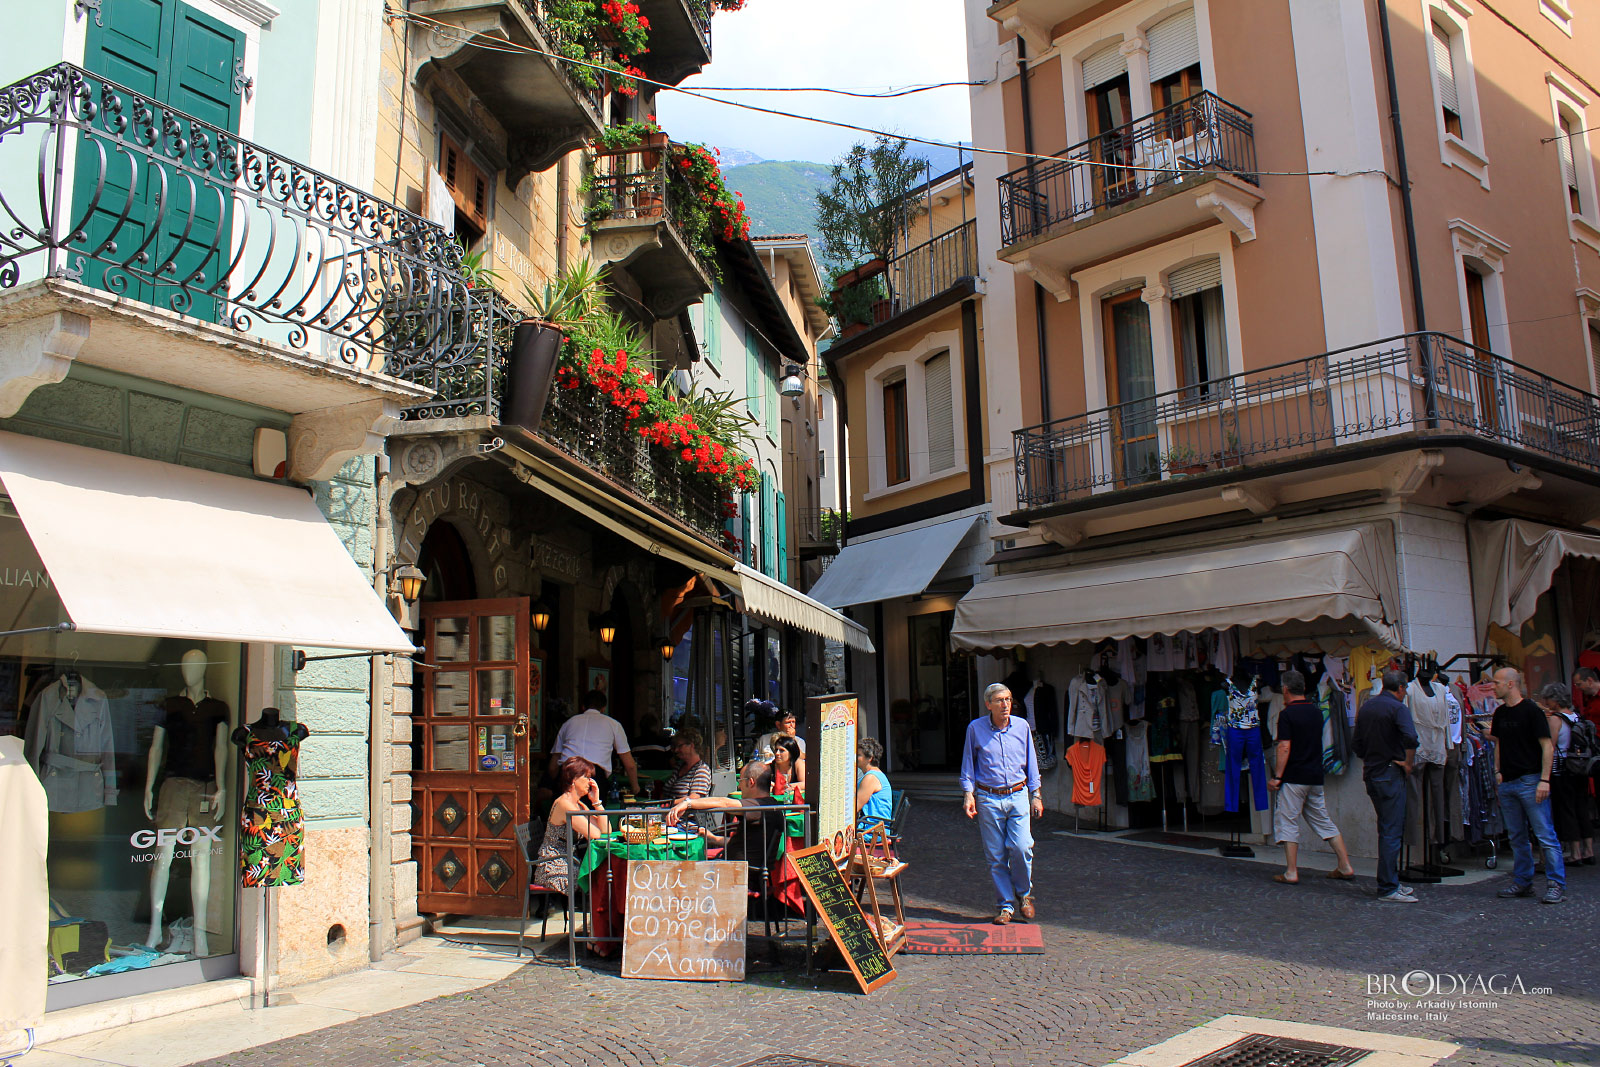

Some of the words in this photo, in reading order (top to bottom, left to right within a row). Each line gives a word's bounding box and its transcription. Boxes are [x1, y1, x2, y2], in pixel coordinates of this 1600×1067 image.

[130, 825, 224, 850] GEOX
[131, 852, 165, 864] NUOVA
[633, 863, 688, 891] Qui
[702, 869, 720, 890] si
[629, 892, 720, 921] mangia
[629, 915, 704, 938] come
[630, 942, 745, 977] Mamma
